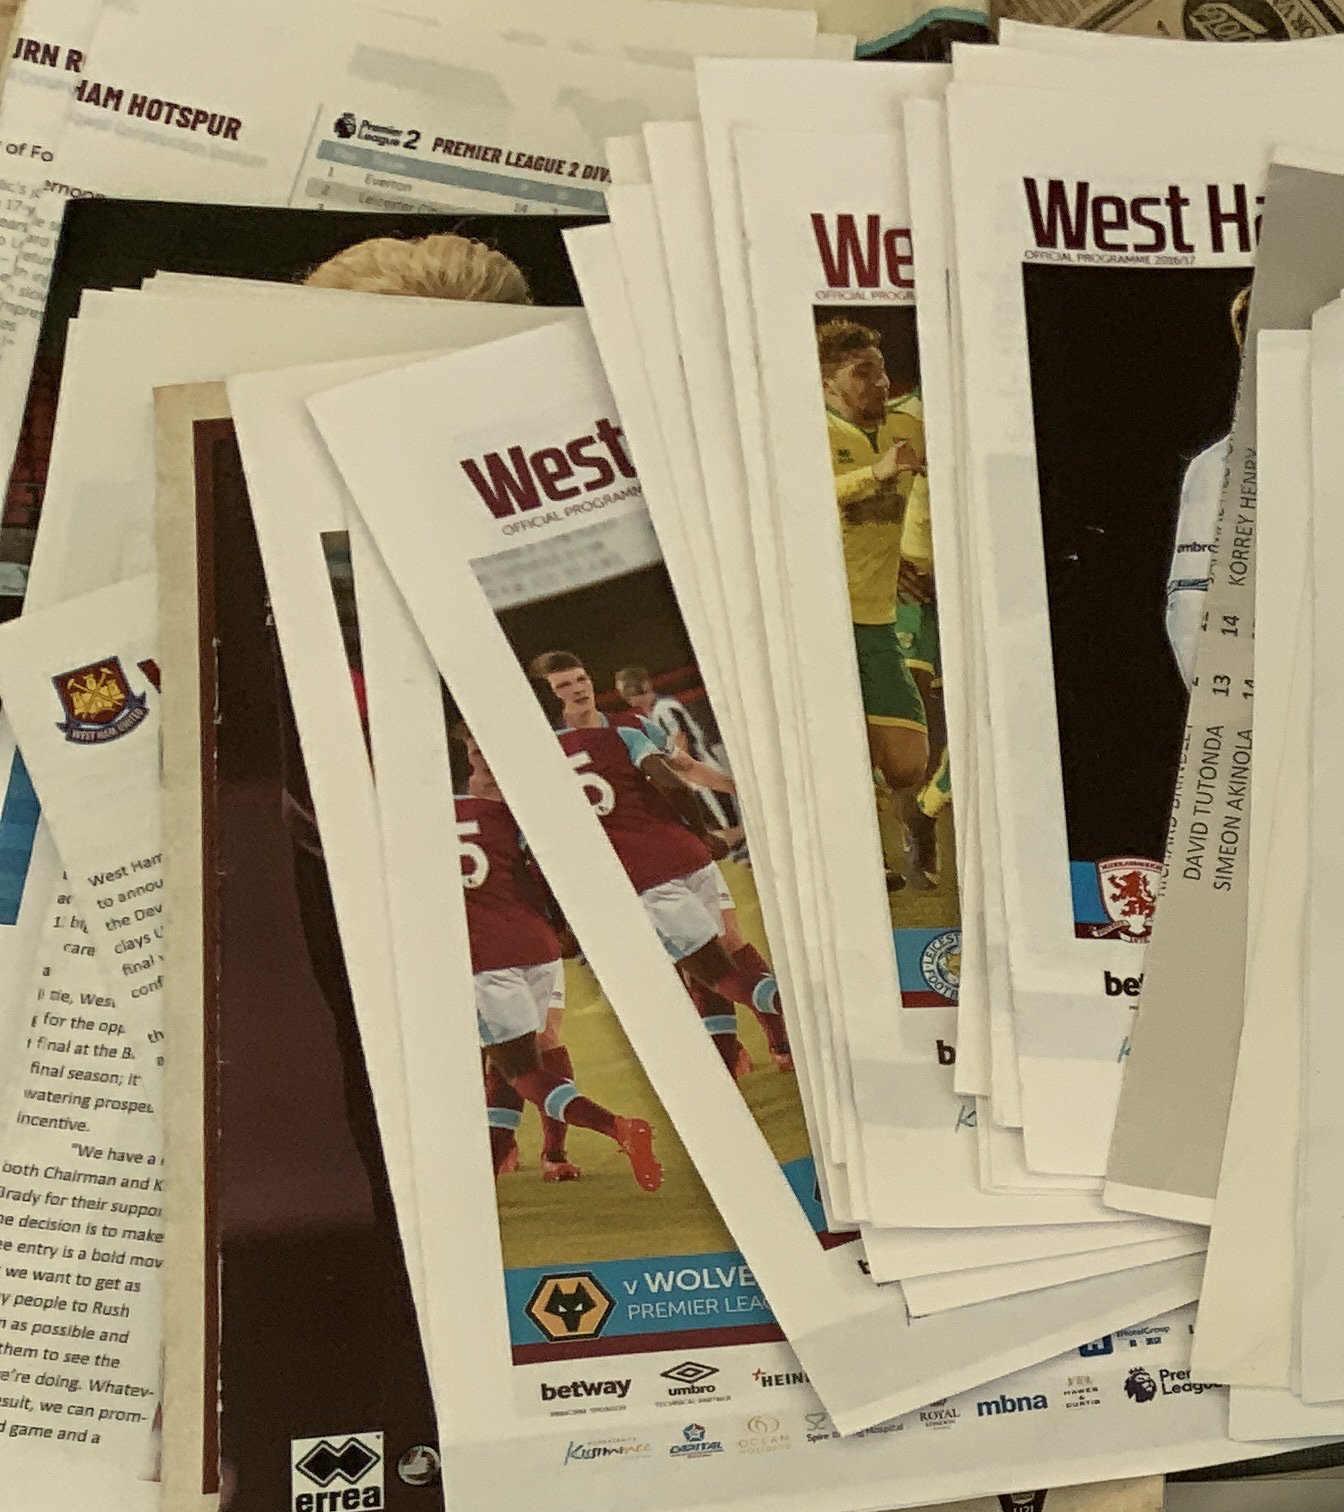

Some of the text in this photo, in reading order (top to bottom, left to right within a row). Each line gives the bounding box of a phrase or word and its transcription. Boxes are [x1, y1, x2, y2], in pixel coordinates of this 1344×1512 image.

[127, 93, 242, 141] HOTSPUR
[432, 137, 579, 177] PREMIER LEAGUE 2
[1023, 177, 1194, 253] West
[1024, 250, 1073, 262] OFFICIAL
[460, 418, 642, 519] West
[502, 512, 562, 535] OFFICIAL
[1183, 726, 1225, 881] DAVID TUTONDA
[1213, 729, 1253, 892] SIMEON AKINOLA
[628, 1298, 719, 1320] PREMIER
[541, 1379, 631, 1401] betway
[667, 1382, 717, 1396] umbro
[977, 1395, 1048, 1416] mbna
